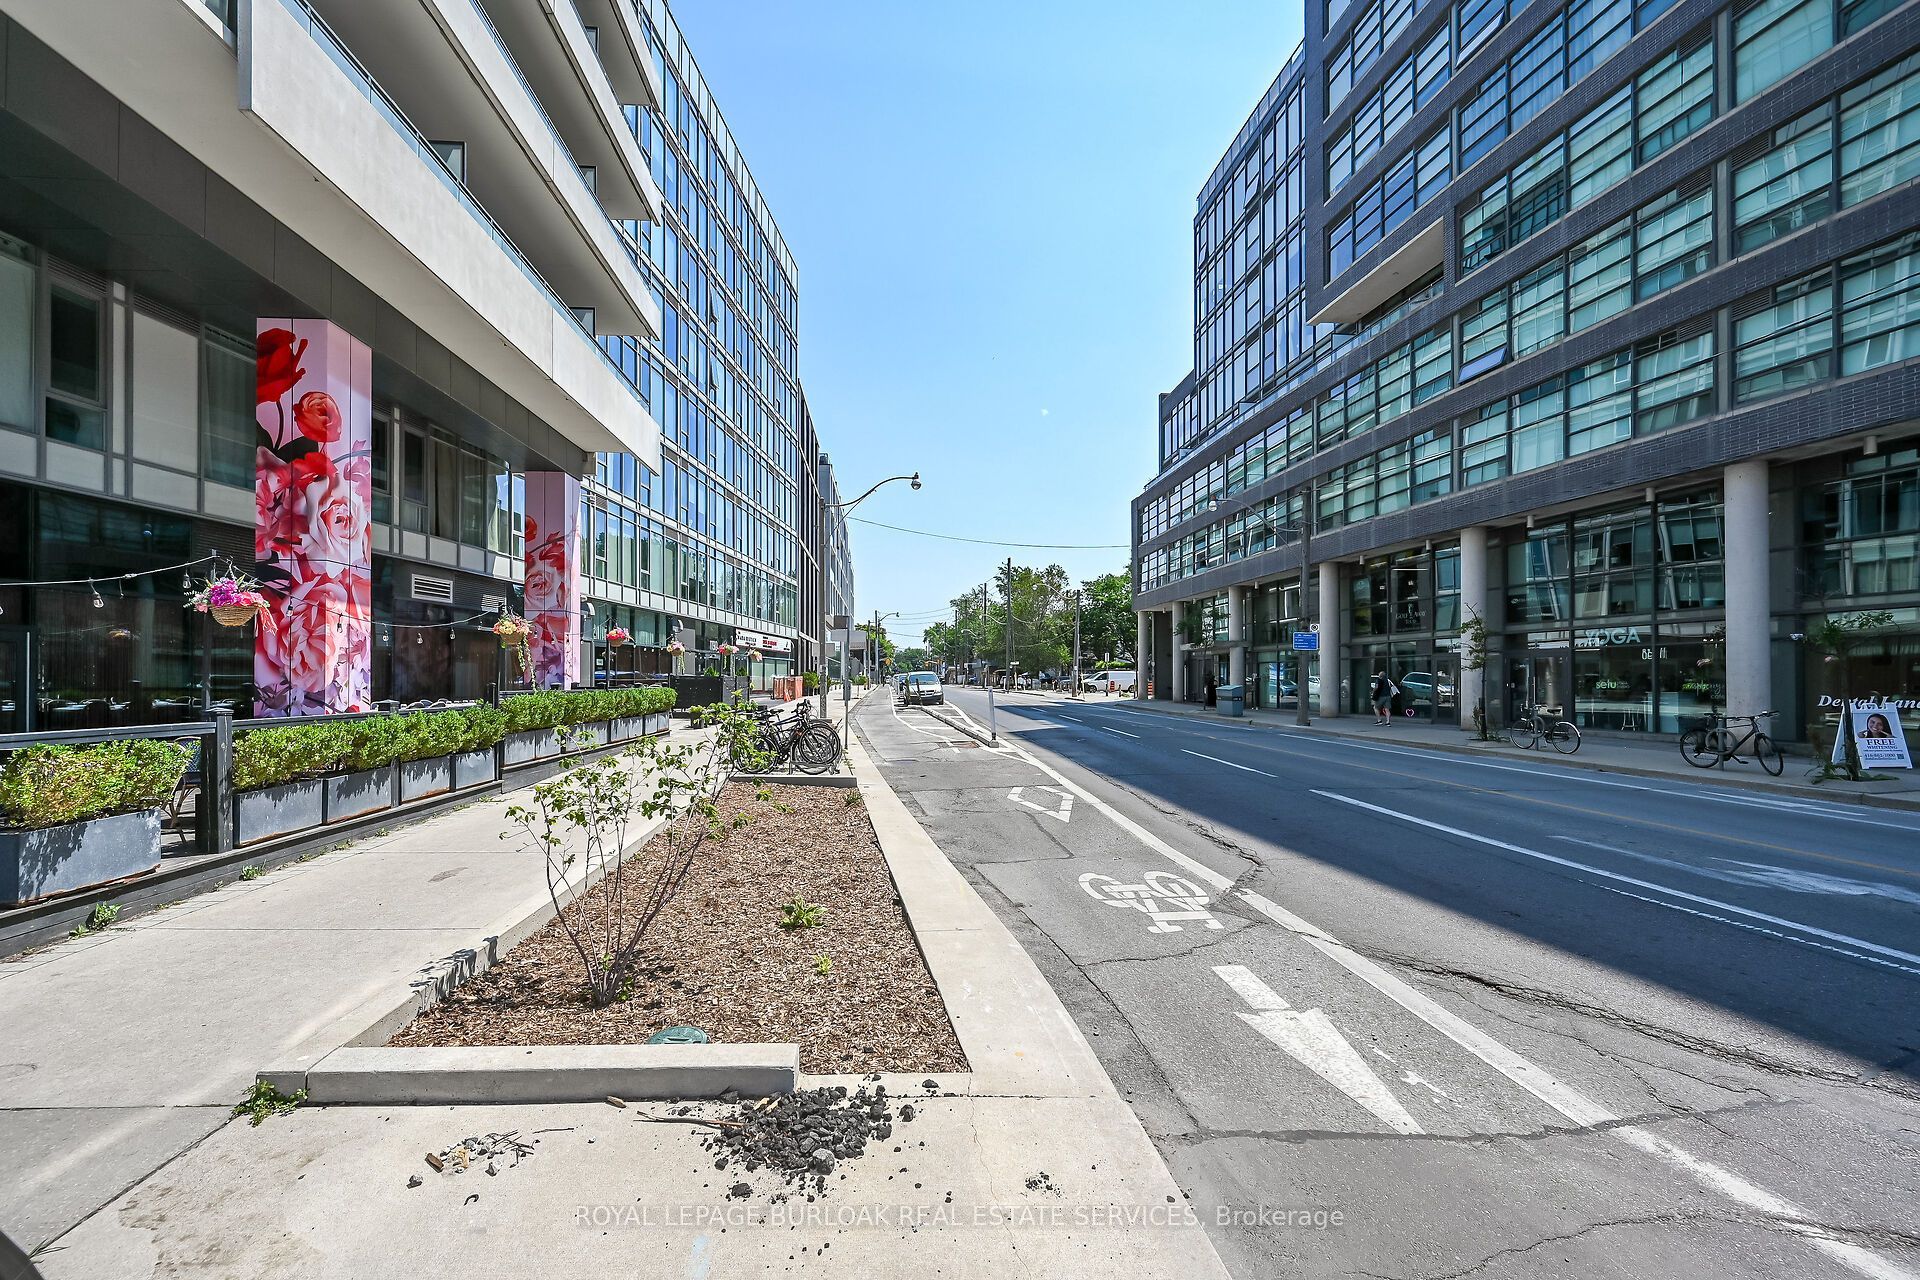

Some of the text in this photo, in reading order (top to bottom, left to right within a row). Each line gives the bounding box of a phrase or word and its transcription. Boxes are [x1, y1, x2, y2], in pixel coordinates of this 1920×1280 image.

[1585, 626, 1641, 646] YOGA
[1817, 694, 1876, 710] Detal
[1866, 738, 1896, 746] FREE
